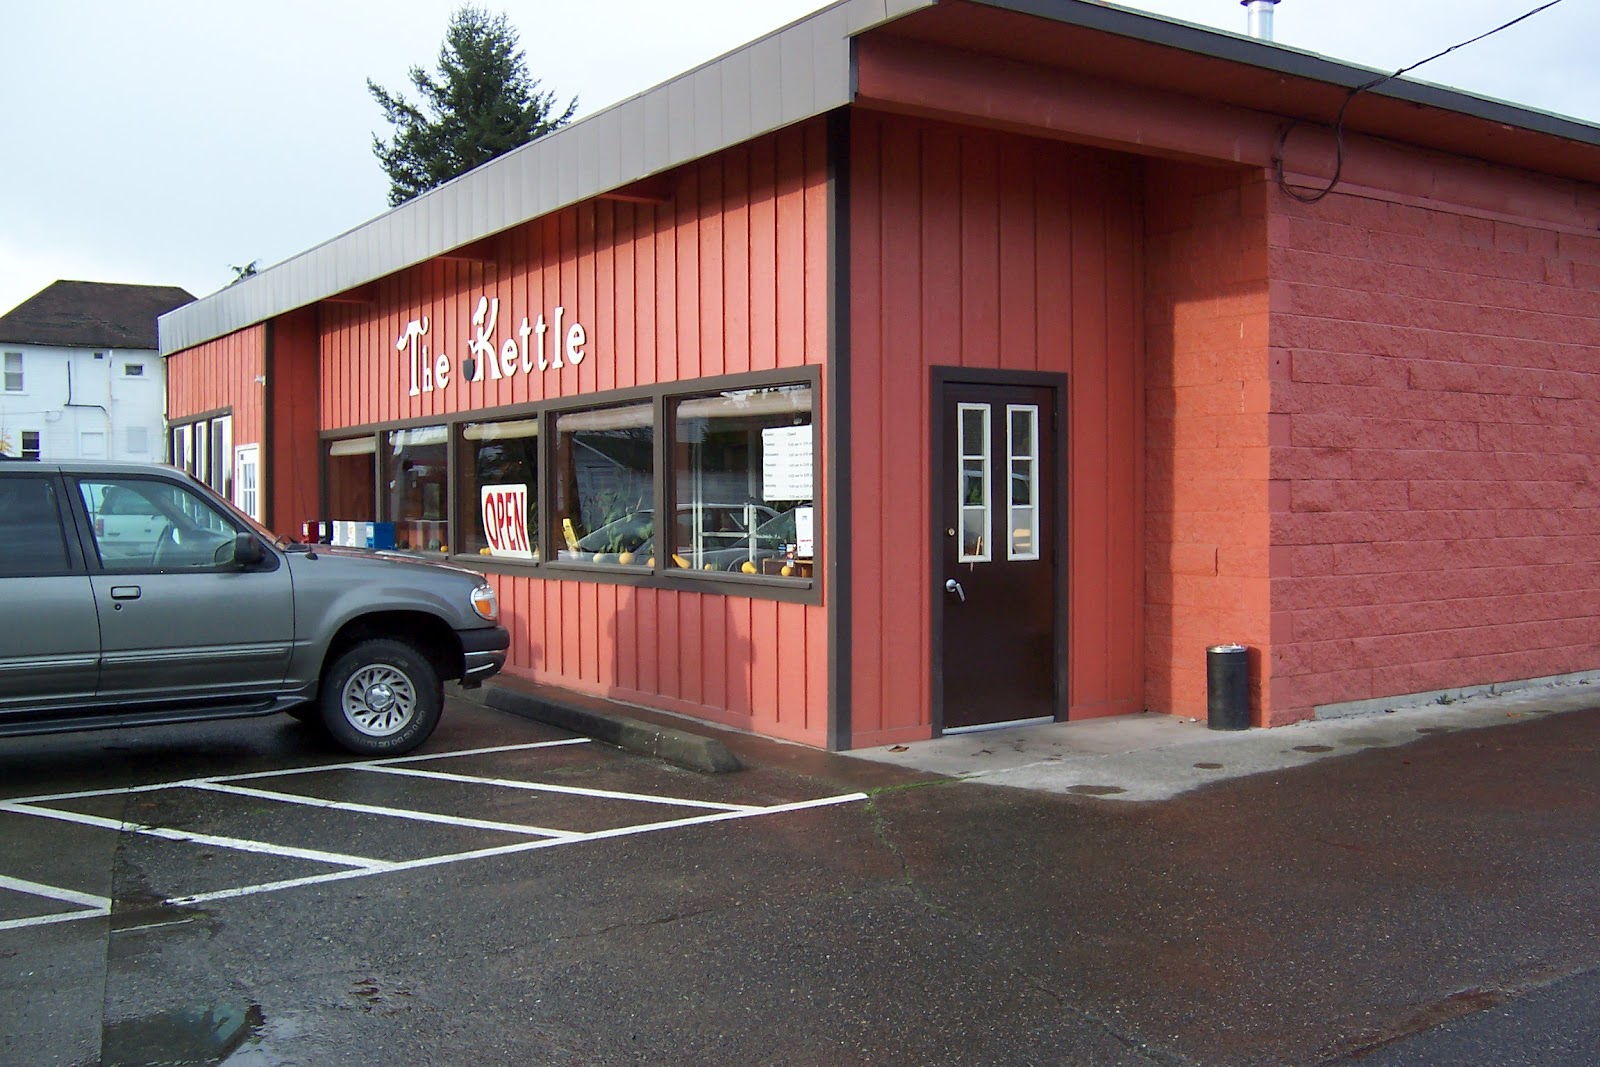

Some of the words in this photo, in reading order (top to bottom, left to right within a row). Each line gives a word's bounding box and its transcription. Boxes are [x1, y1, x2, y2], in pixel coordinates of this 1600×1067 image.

[396, 316, 450, 397] The
[468, 296, 586, 382] Kettle
[485, 492, 528, 551] OPEN
